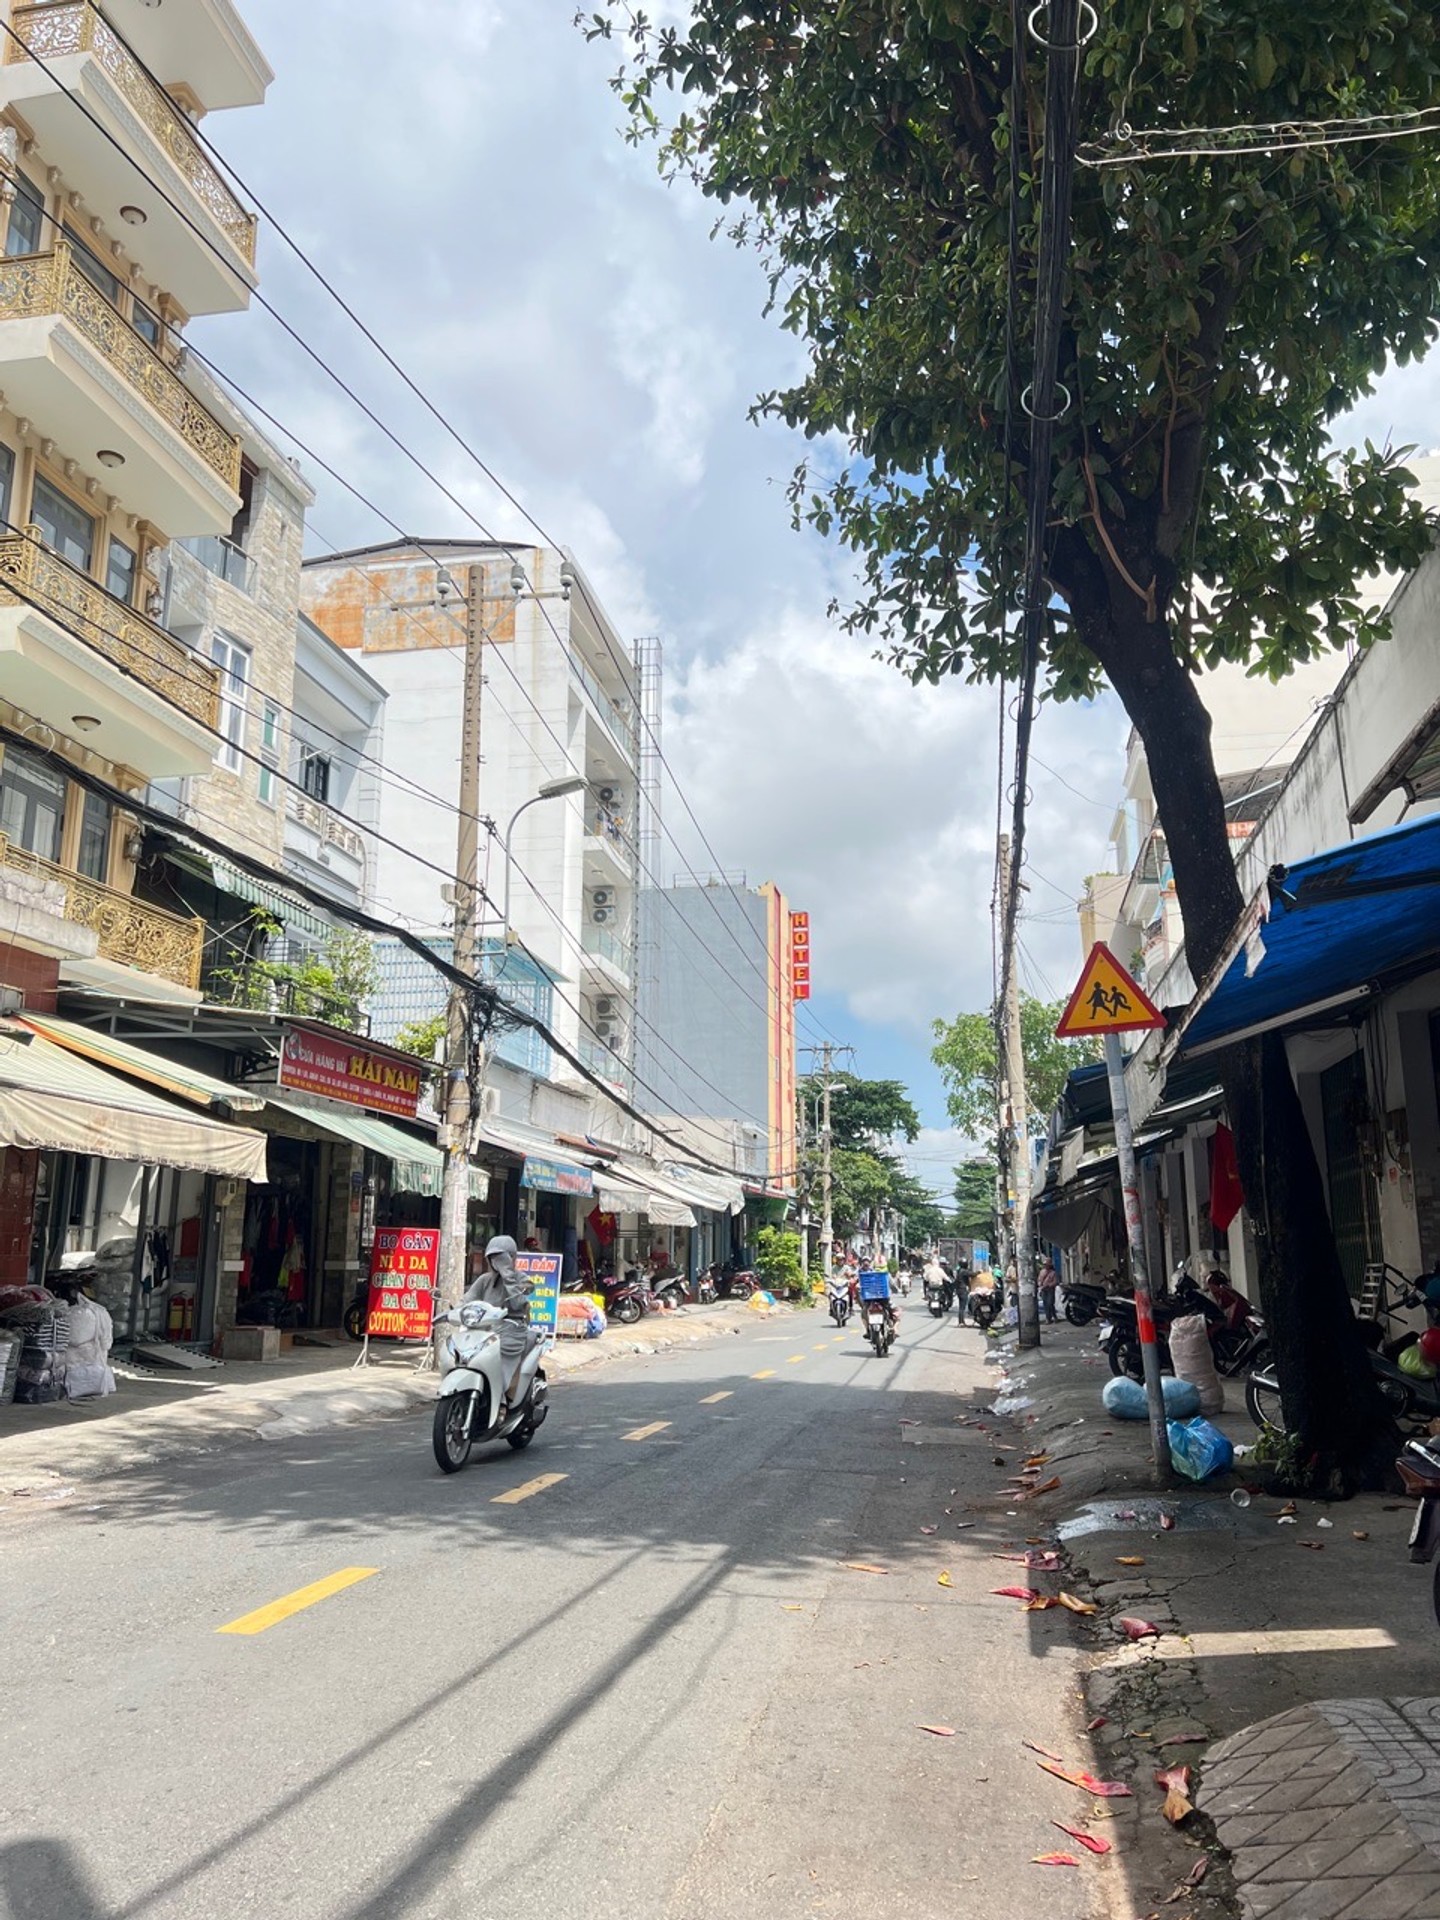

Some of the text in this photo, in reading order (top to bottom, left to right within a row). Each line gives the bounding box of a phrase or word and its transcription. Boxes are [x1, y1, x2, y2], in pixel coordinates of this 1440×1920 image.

[794, 913, 807, 998] HOTEL
[349, 1053, 382, 1083] HẢI
[384, 1067, 417, 1093] NAM
[379, 1231, 433, 1251] BO GÂN
[409, 1256, 428, 1270] DA
[515, 1256, 557, 1272] UA BÁN
[372, 1269, 405, 1289] CHÂN
[401, 1290, 419, 1310] CÁ
[368, 1311, 405, 1333] COTTON
